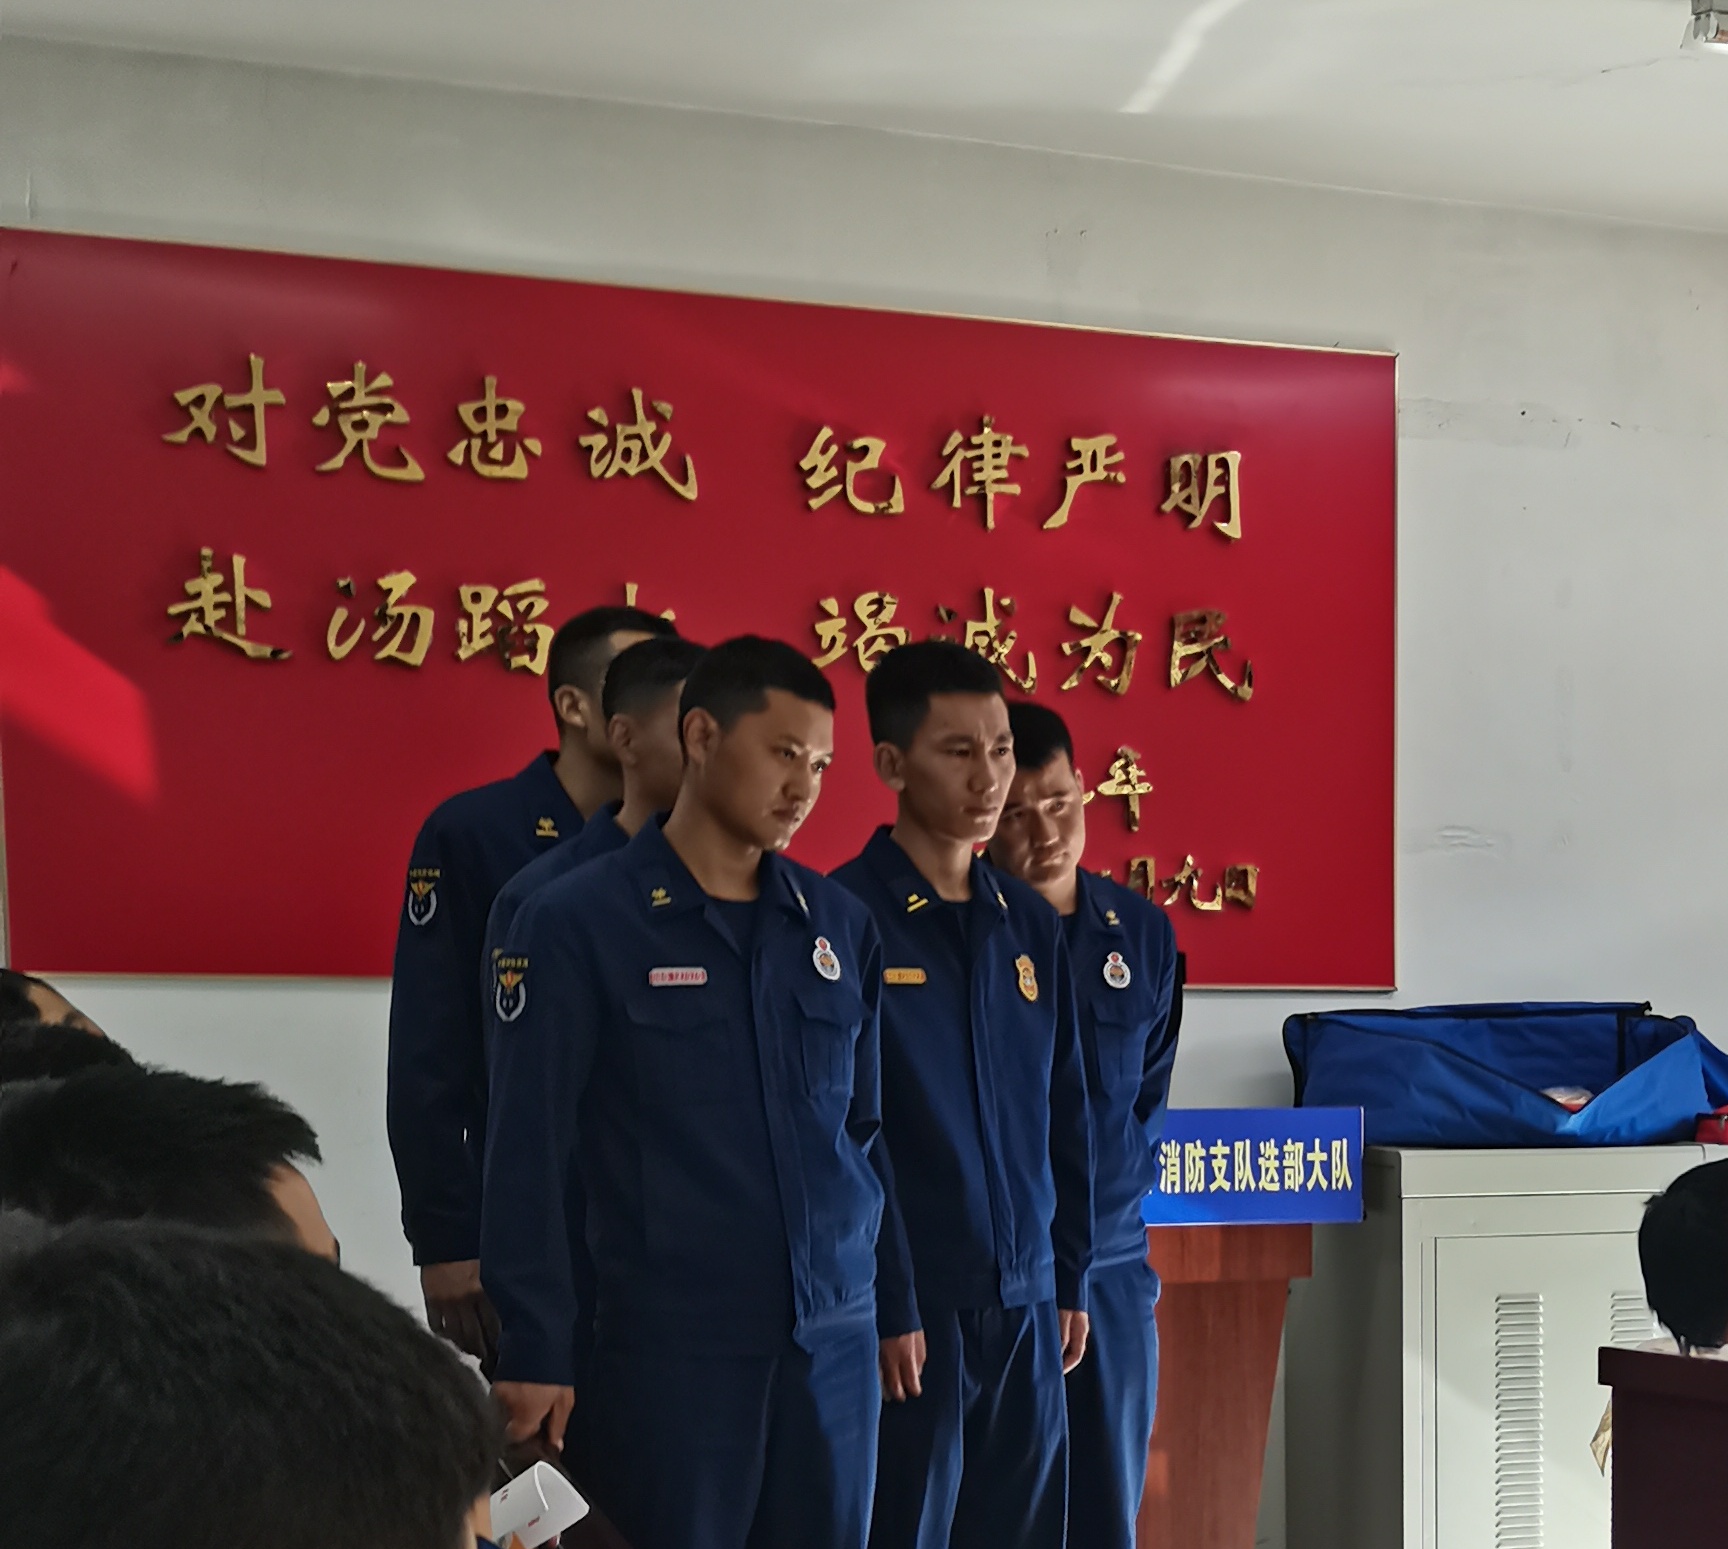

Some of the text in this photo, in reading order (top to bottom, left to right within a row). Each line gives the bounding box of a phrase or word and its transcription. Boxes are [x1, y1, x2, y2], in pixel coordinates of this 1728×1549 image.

[162, 353, 1246, 542] 对党忠诚 纪律严明
[167, 546, 676, 675] 赴汤蹈
[1082, 745, 1153, 832] 年
[1100, 854, 1259, 912] 月九日
[1159, 1138, 1353, 1194] 消防支队迭部大队
